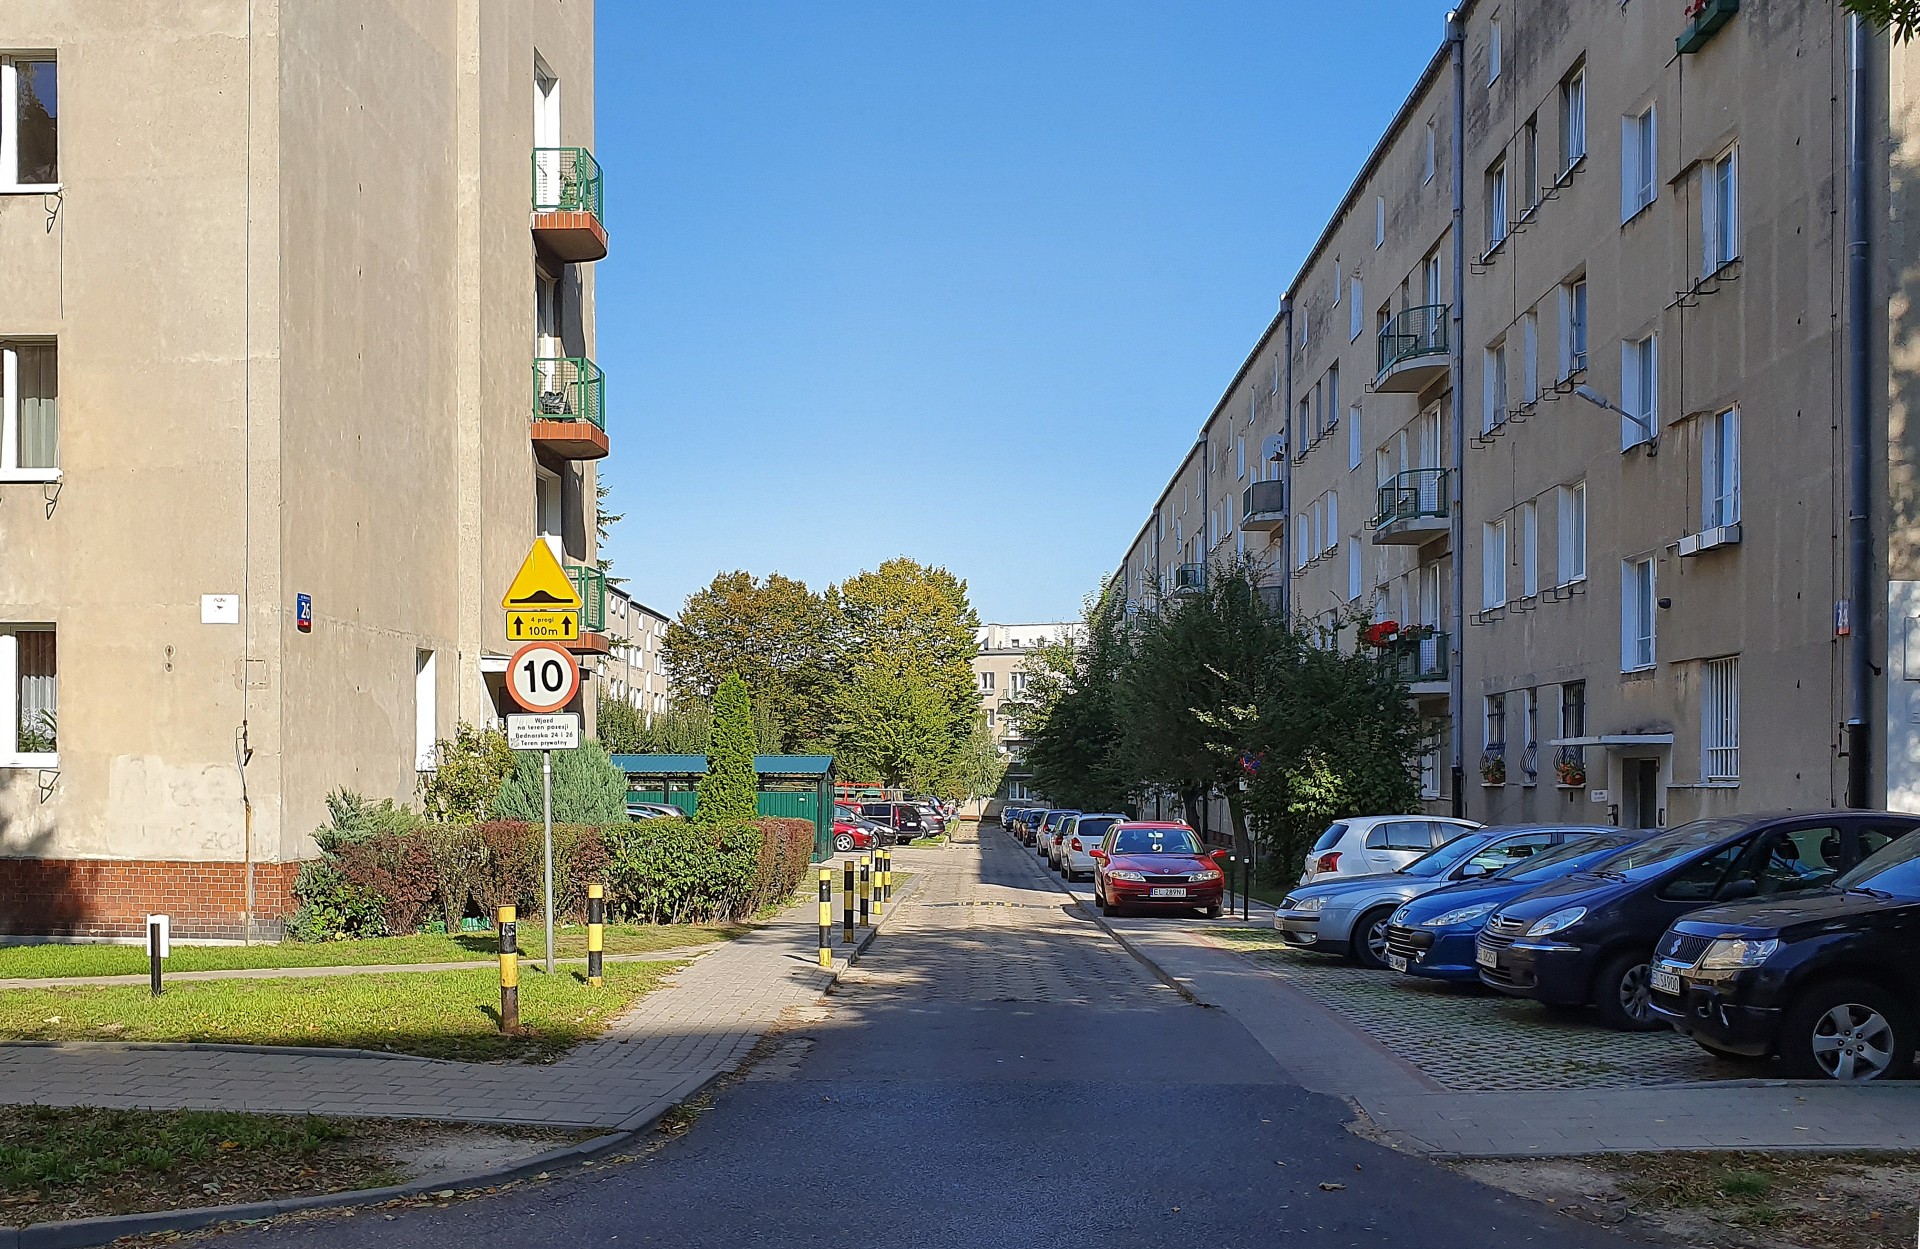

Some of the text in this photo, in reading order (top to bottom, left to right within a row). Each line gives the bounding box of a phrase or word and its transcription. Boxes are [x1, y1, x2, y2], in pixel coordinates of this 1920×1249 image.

[300, 602, 310, 620] 26
[529, 626, 558, 636] 100m
[524, 660, 564, 692] 10
